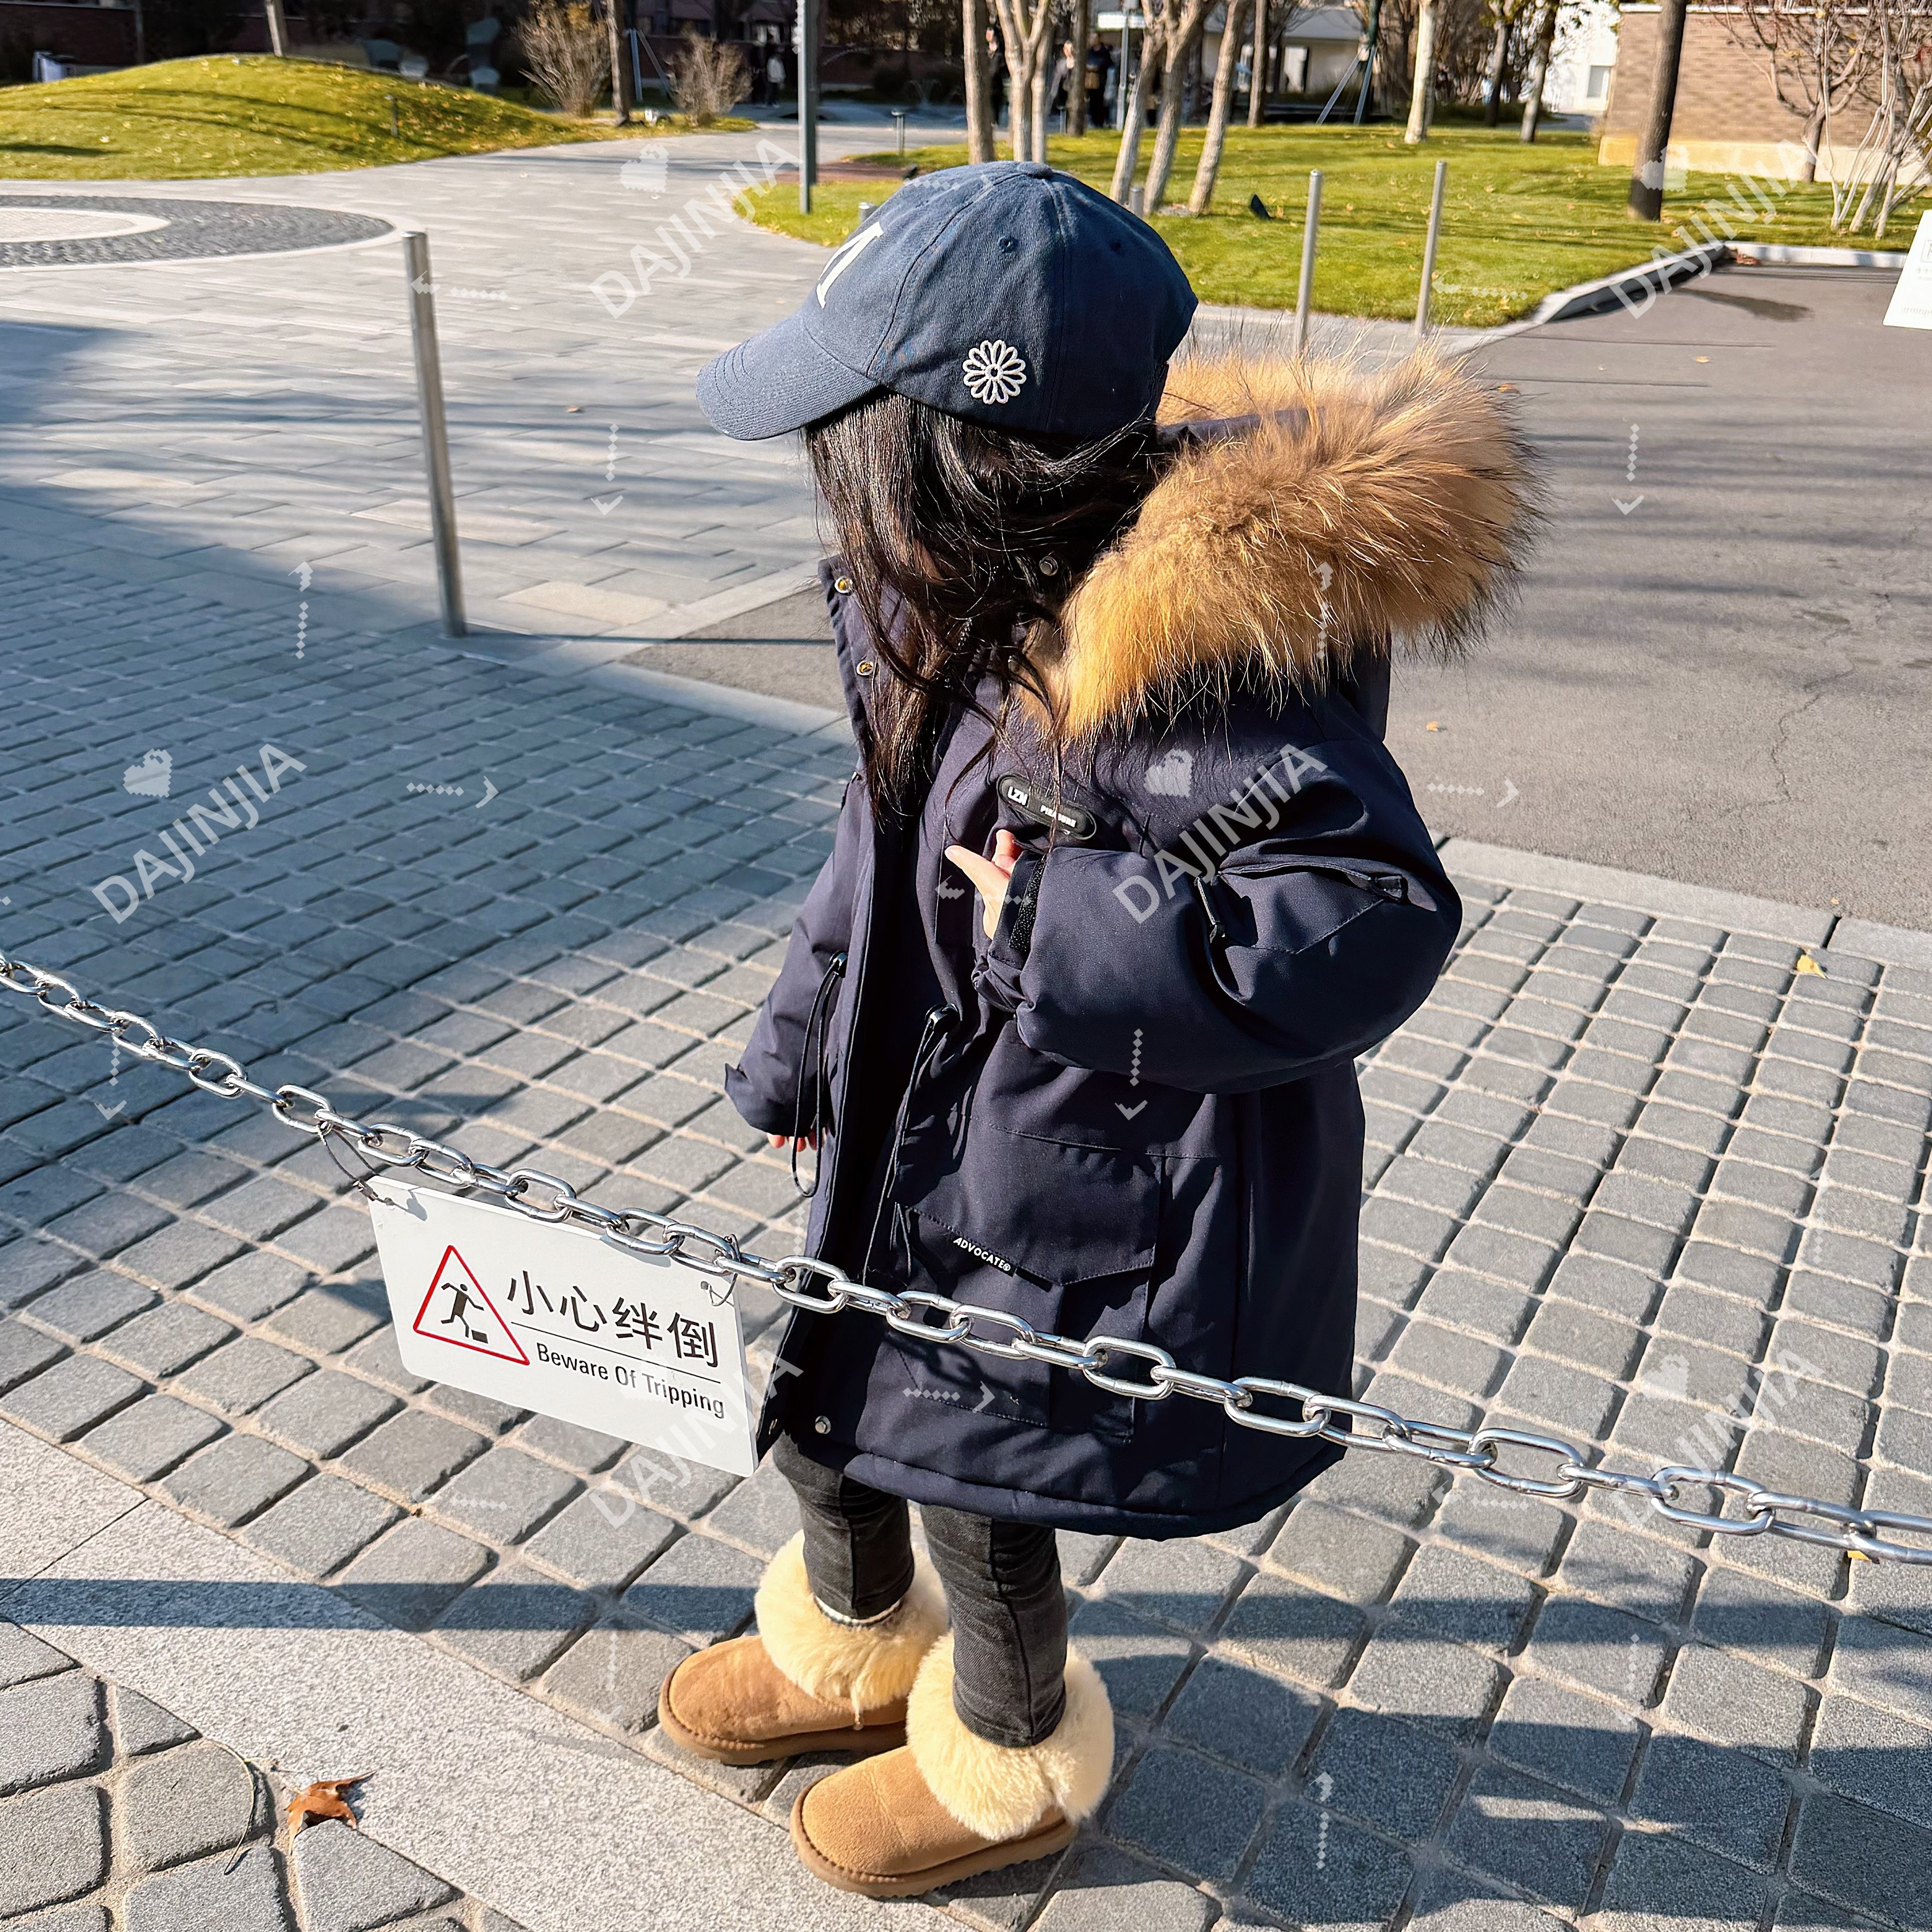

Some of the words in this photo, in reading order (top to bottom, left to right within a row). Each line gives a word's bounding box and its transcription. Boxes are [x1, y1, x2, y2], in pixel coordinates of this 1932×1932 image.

[507, 1270, 718, 1368] 小心绊倒
[536, 1342, 609, 1381] Beware
[615, 1366, 637, 1388] Of
[642, 1373, 725, 1419] Tripping
